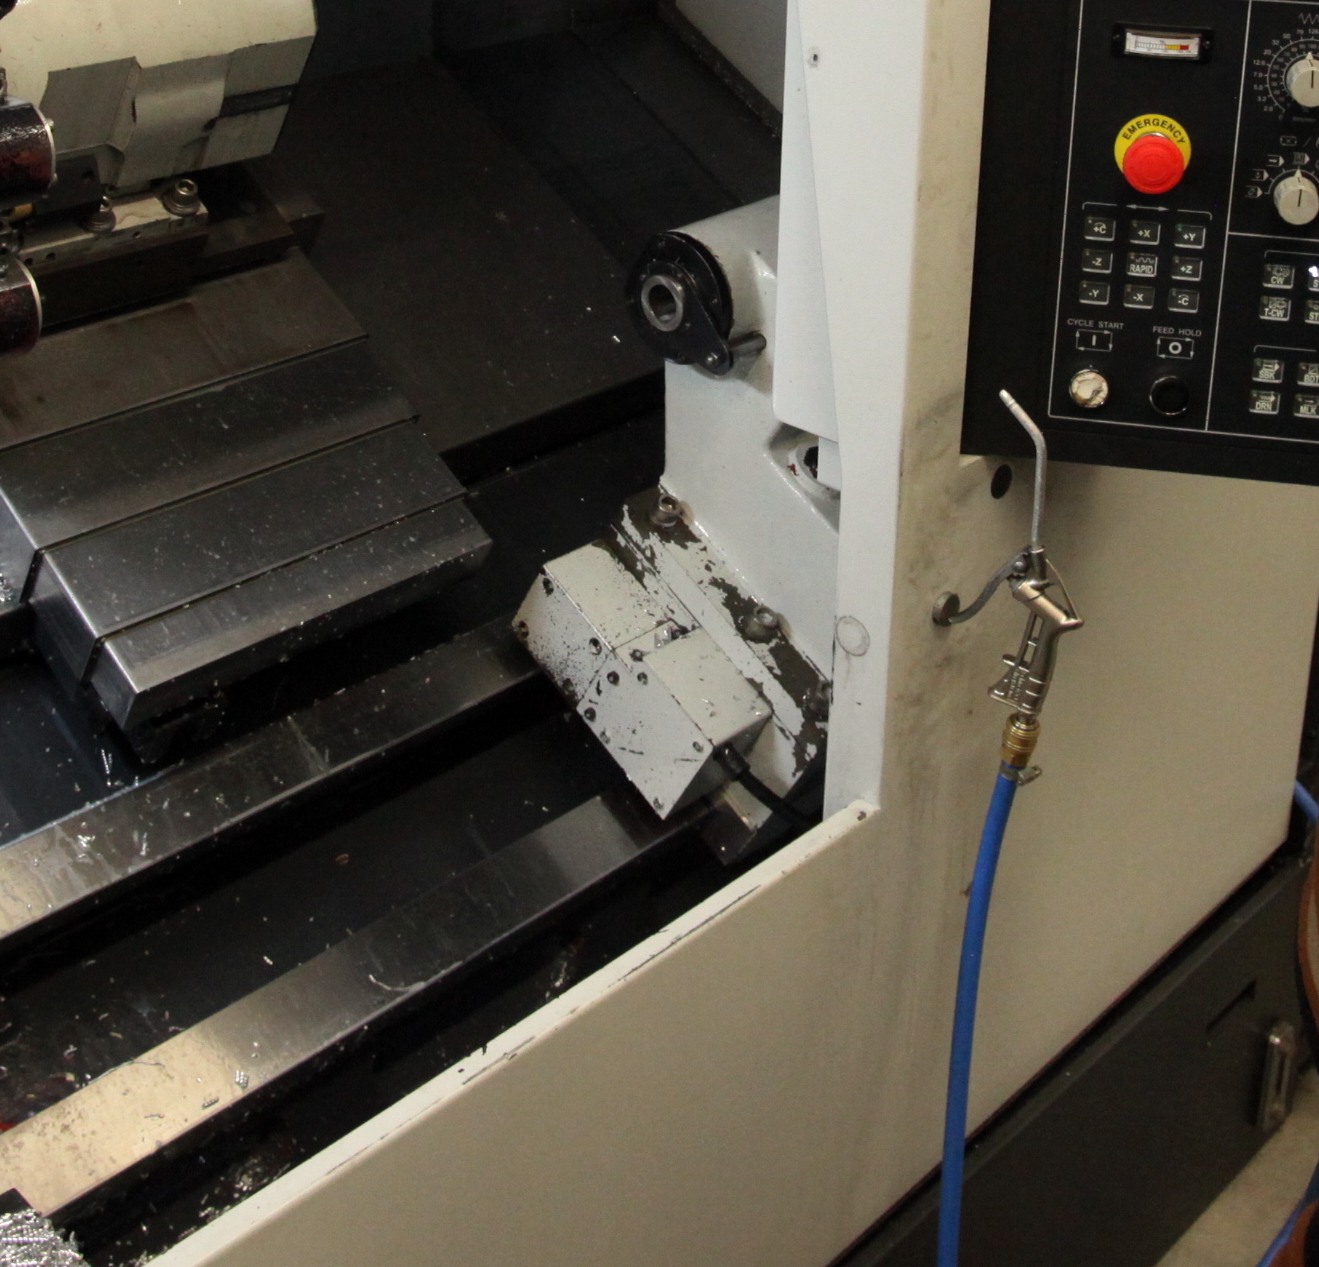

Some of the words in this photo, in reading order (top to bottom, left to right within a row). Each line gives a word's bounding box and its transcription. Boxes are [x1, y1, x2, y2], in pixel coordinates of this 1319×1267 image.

[1122, 118, 1186, 145] EMERGENCY
[1138, 229, 1151, 238] +X
[1183, 233, 1196, 241] +Y
[1092, 257, 1102, 266] -Z
[1130, 264, 1154, 274] RAPID
[1180, 265, 1194, 274] +Z
[1270, 277, 1286, 285] CW
[1088, 289, 1099, 298] -Y
[1132, 293, 1144, 302] -X
[1264, 308, 1286, 317] T-CW
[1066, 318, 1094, 327] CYCLE
[1098, 321, 1124, 330] START
[1152, 325, 1175, 335] FEED
[1178, 329, 1202, 337] HOLD
[1258, 371, 1276, 379] SBK
[1256, 401, 1272, 411] DRN
[1300, 405, 1318, 415] MLK
